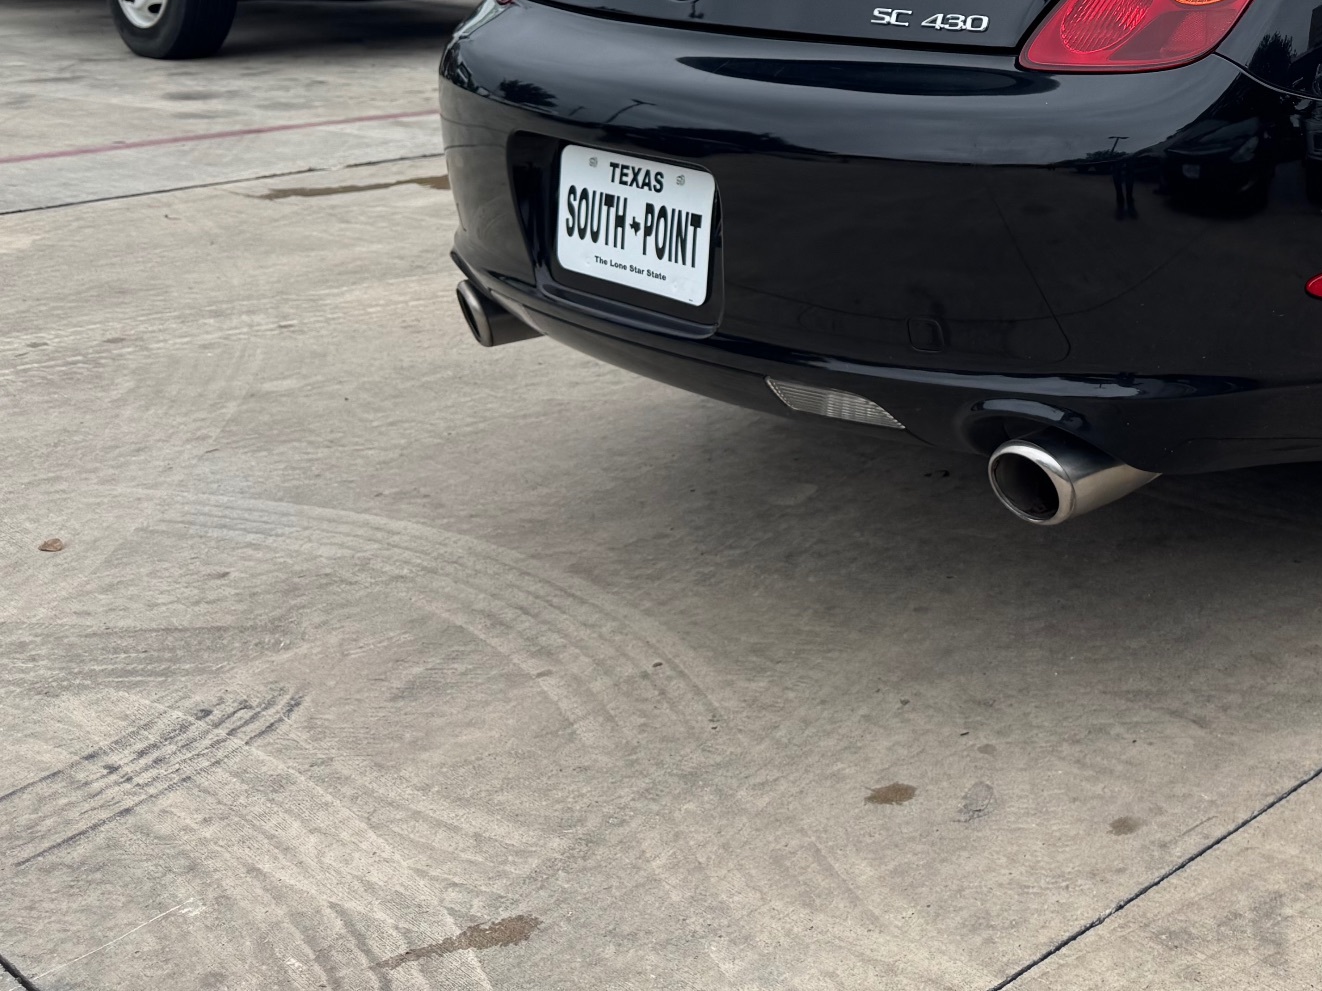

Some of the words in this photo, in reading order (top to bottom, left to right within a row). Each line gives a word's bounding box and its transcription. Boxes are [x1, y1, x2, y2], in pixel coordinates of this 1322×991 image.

[870, 7, 913, 27] SC
[921, 13, 989, 32] 430
[609, 161, 665, 194] TEXAS
[565, 184, 628, 250] SOUTH
[642, 202, 703, 269] POINT
[594, 255, 608, 266] The
[610, 259, 628, 271] Lone
[629, 264, 645, 275] Star
[646, 269, 667, 281] State
